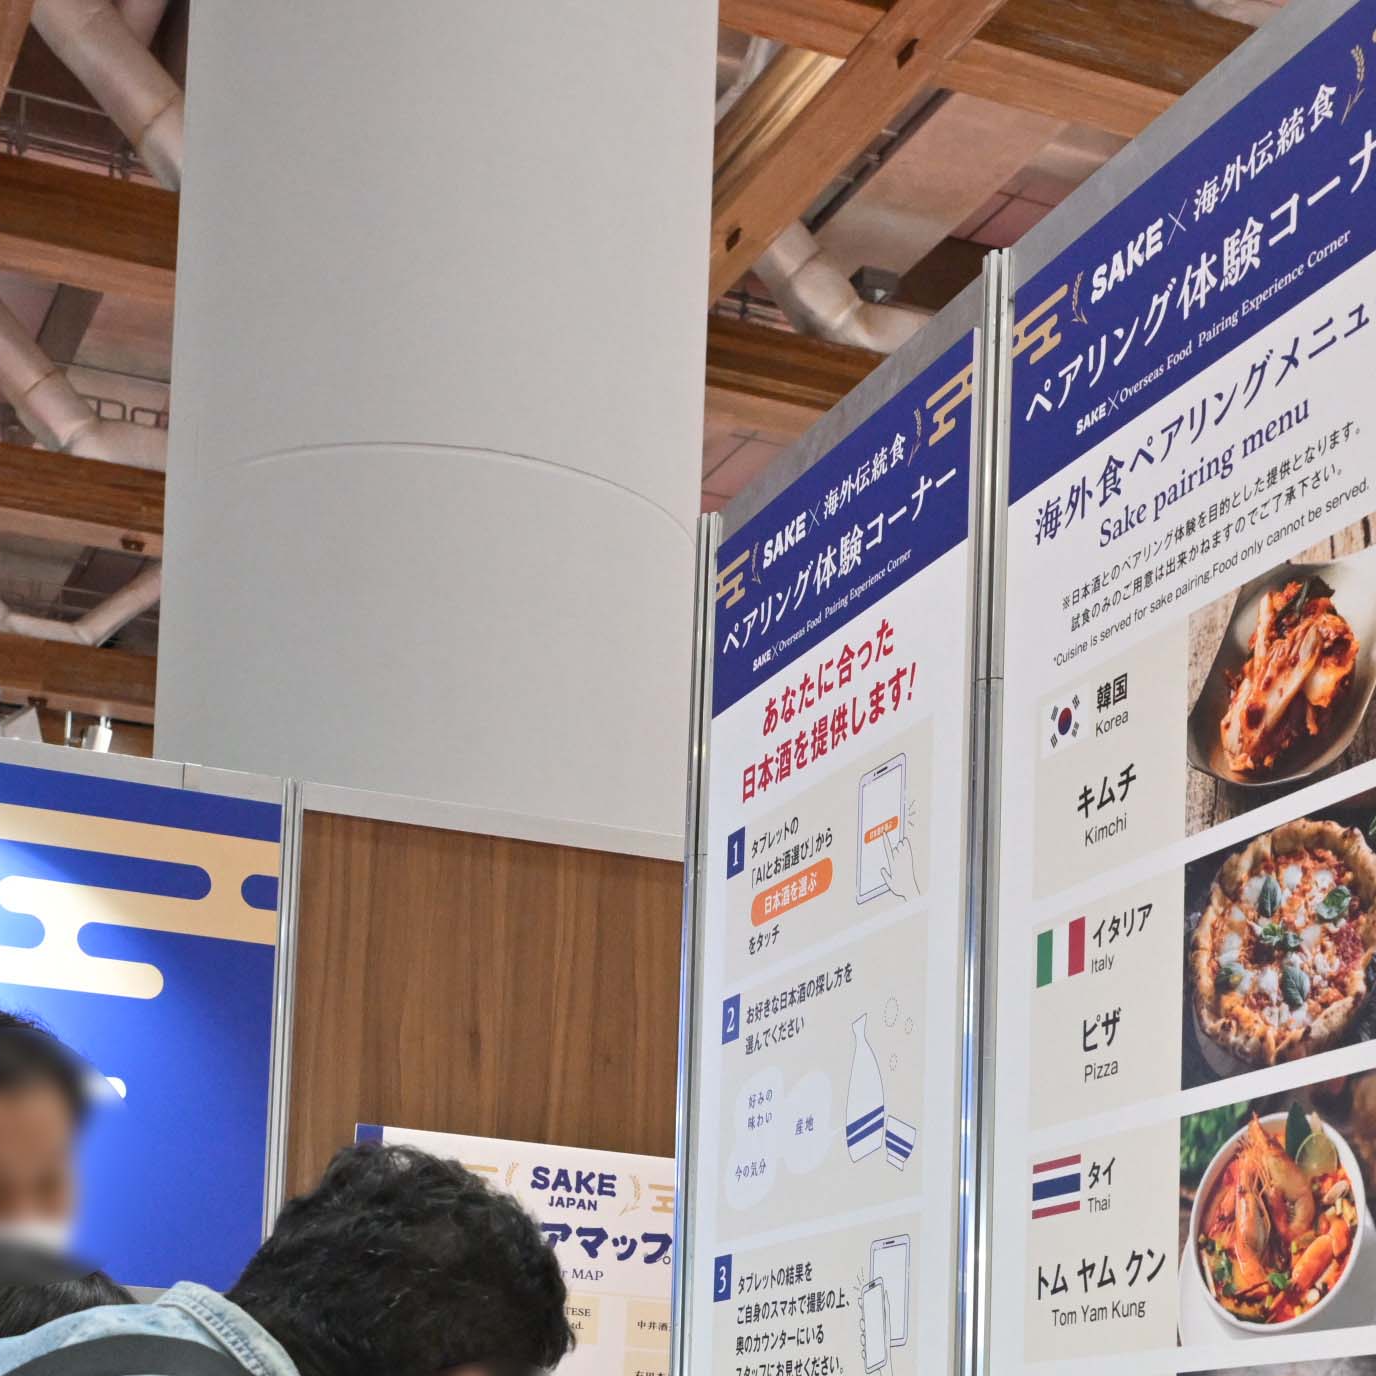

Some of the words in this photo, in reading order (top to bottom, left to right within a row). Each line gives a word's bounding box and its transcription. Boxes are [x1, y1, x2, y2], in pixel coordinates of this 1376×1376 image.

[1166, 344, 1193, 371] Food
[1198, 309, 1239, 348] Pairing
[1241, 262, 1305, 317] Experience
[1307, 230, 1352, 271] Corner
[1099, 502, 1147, 548] Sake
[1153, 445, 1234, 523] pairing
[1242, 398, 1310, 458] menu
[723, 467, 957, 654] ペアリング体験コーナー
[1100, 612, 1132, 642] served
[1134, 605, 1147, 623] for
[1150, 591, 1174, 614] sake
[1240, 538, 1264, 562] only
[1267, 515, 1305, 546] cannot
[1308, 504, 1322, 523] be
[1326, 477, 1369, 513] served.
[806, 611, 822, 634] Food
[824, 593, 848, 619] Pairing
[849, 568, 886, 602] Experience
[887, 549, 912, 573] Corner
[763, 618, 894, 737] あなたに合った
[1096, 672, 1128, 714] 韓国
[1095, 709, 1129, 737] Korea
[1076, 762, 1137, 819] キムチ
[751, 816, 799, 859] タブレットの
[1084, 812, 1127, 847] Kimchi
[751, 827, 833, 889] 「AIとお酒選び」から
[764, 868, 817, 915] 日本酒を選ぶ
[748, 924, 780, 956] をタッチ
[1093, 903, 1153, 948] イタリア
[1090, 952, 1115, 977] Italy
[746, 962, 853, 1025] お好きな日本酒の探し方を
[745, 1014, 805, 1055] 選んでください
[1083, 1008, 1121, 1053] ピザ
[1084, 1056, 1119, 1083] Pizza
[748, 1088, 773, 1109] 好みの
[747, 1111, 773, 1131] 味わい
[794, 1114, 815, 1136] 産地
[530, 1165, 617, 1198] SAKE
[735, 1157, 767, 1183] 今の気分
[1088, 1157, 1116, 1190] タイ
[548, 1196, 598, 1212] JAPAN
[1088, 1196, 1111, 1215] Thai
[571, 1268, 604, 1281] MAP
[737, 1261, 813, 1294] タブレットの結果を
[736, 1287, 851, 1326] ご自身のスマホで撮影の上、
[1051, 1307, 1077, 1327] Tom
[1080, 1303, 1108, 1323] Yam
[1112, 1299, 1146, 1322] Kung
[735, 1324, 825, 1357] 奥のカウンターにいる
